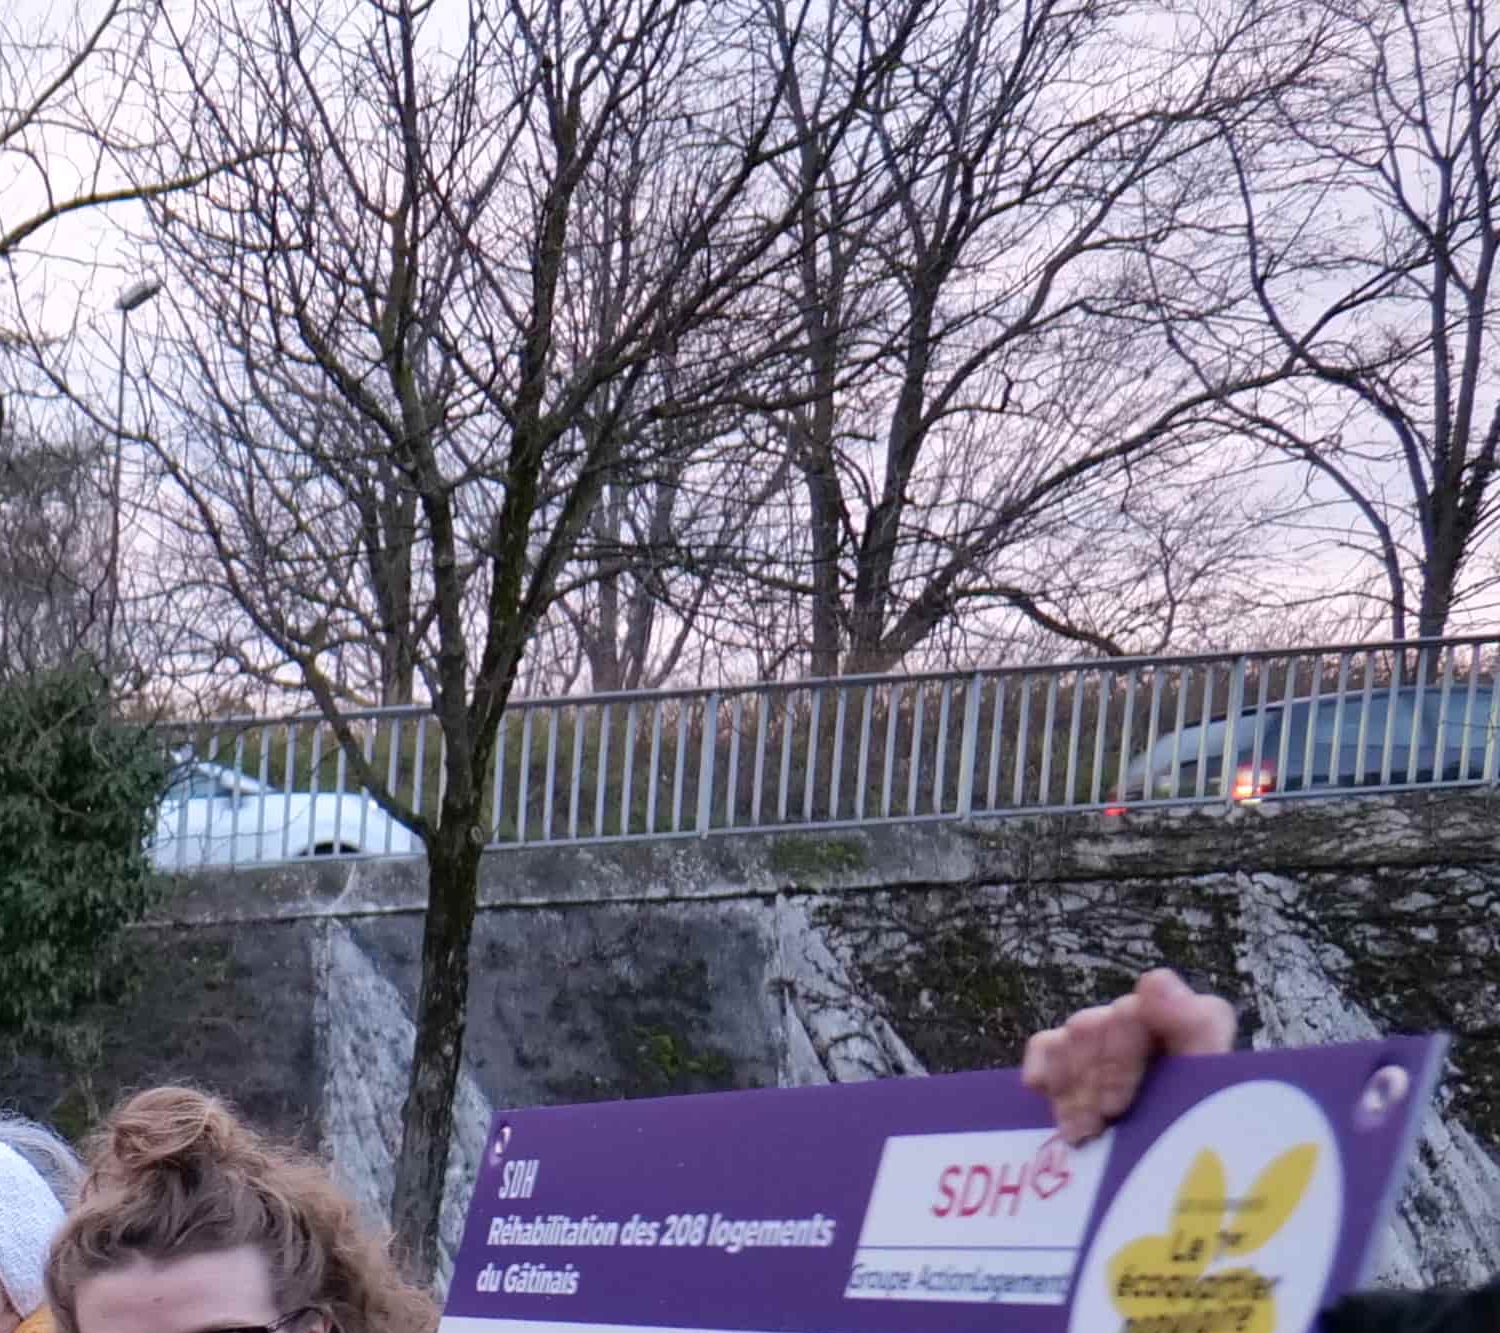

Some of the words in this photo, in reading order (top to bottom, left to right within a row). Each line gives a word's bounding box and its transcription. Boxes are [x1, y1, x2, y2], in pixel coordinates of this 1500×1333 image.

[499, 1159, 539, 1199] SDH
[929, 1162, 1028, 1217] SDH
[487, 1214, 617, 1247] Réhabilitation
[620, 1215, 660, 1246] des
[659, 1213, 704, 1247] 208
[707, 1213, 836, 1253] logements
[1171, 1229, 1204, 1262] Le
[477, 1263, 501, 1292] du
[503, 1262, 581, 1294] Gâtinais
[849, 1263, 915, 1297] Groupe
[1116, 1263, 1283, 1312] écoquartier
